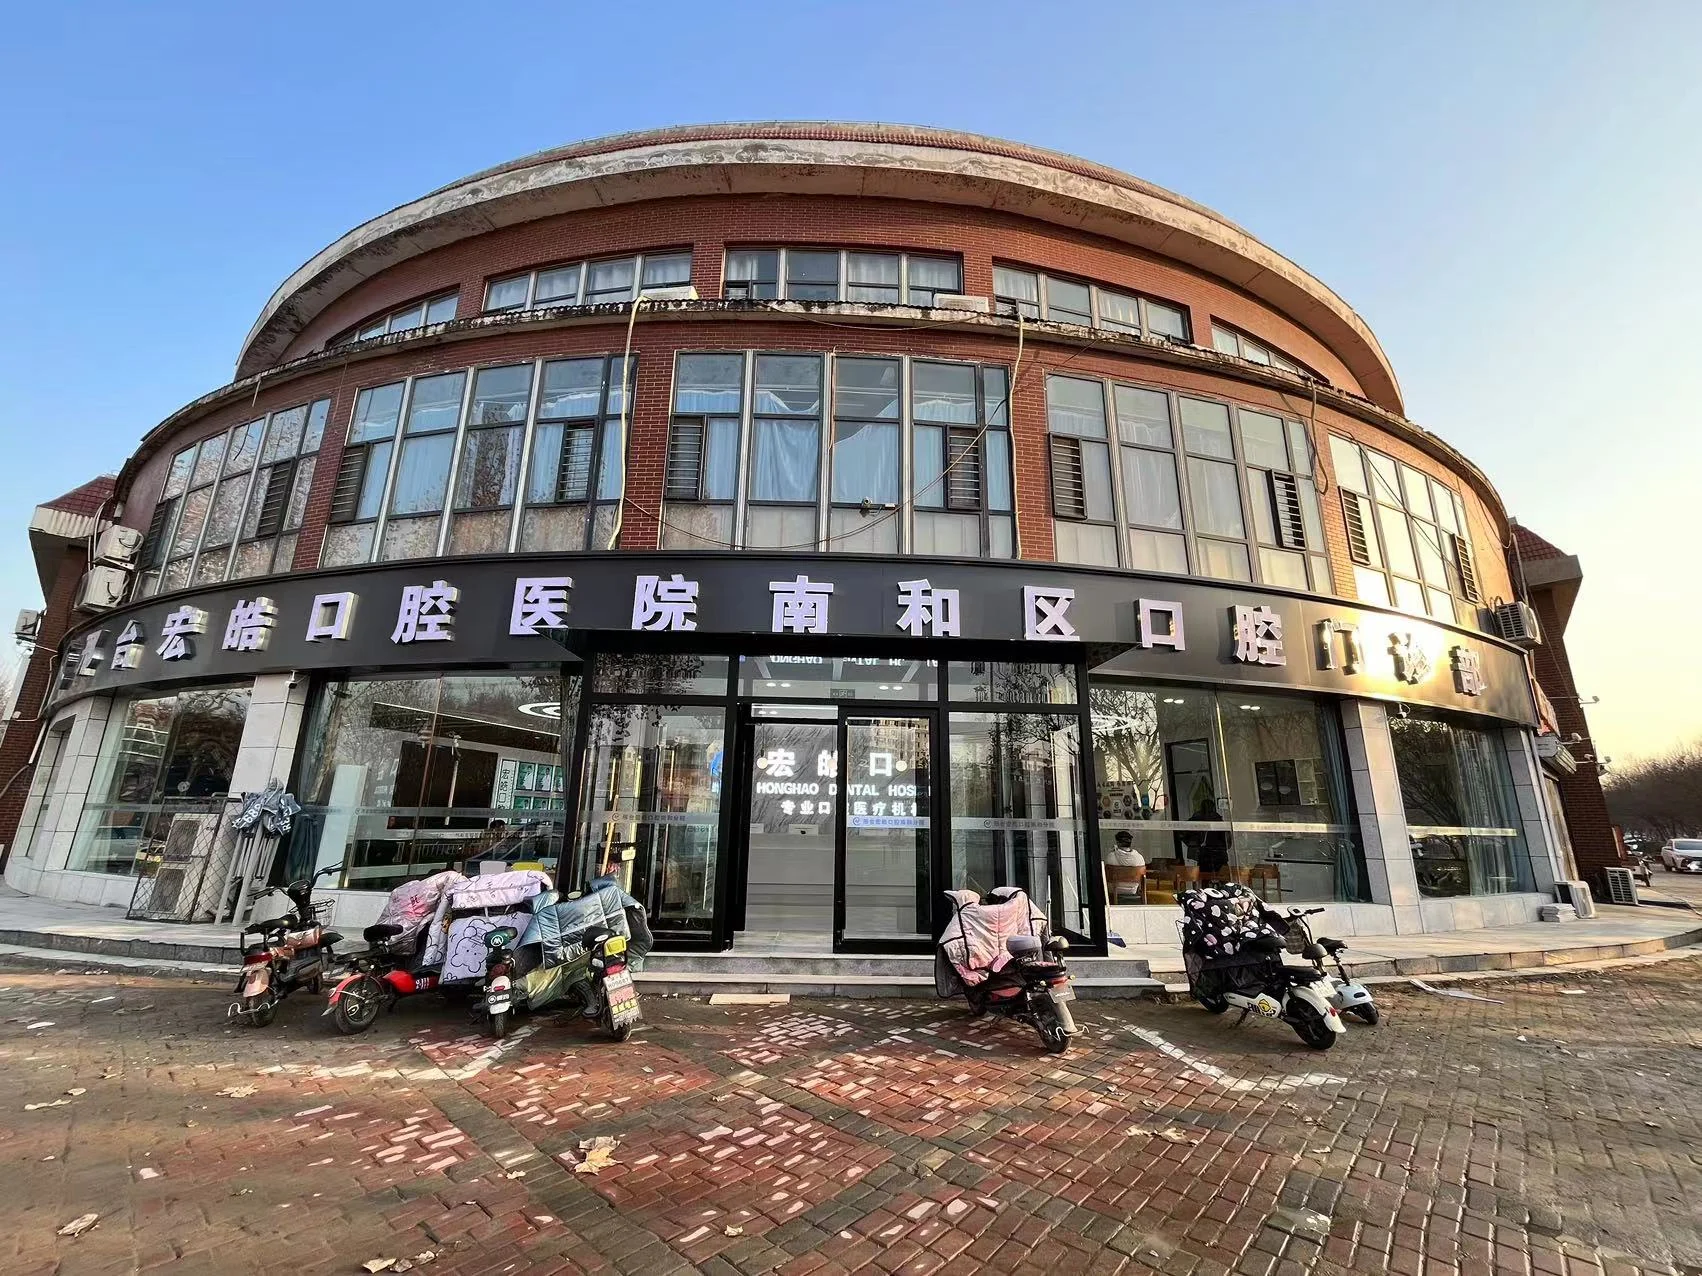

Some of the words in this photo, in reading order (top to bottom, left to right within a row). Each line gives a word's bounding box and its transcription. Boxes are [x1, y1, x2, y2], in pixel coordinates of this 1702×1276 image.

[756, 782, 819, 796] HONGHAO
[829, 783, 880, 797] DNTAL
[887, 784, 917, 797] HOS
